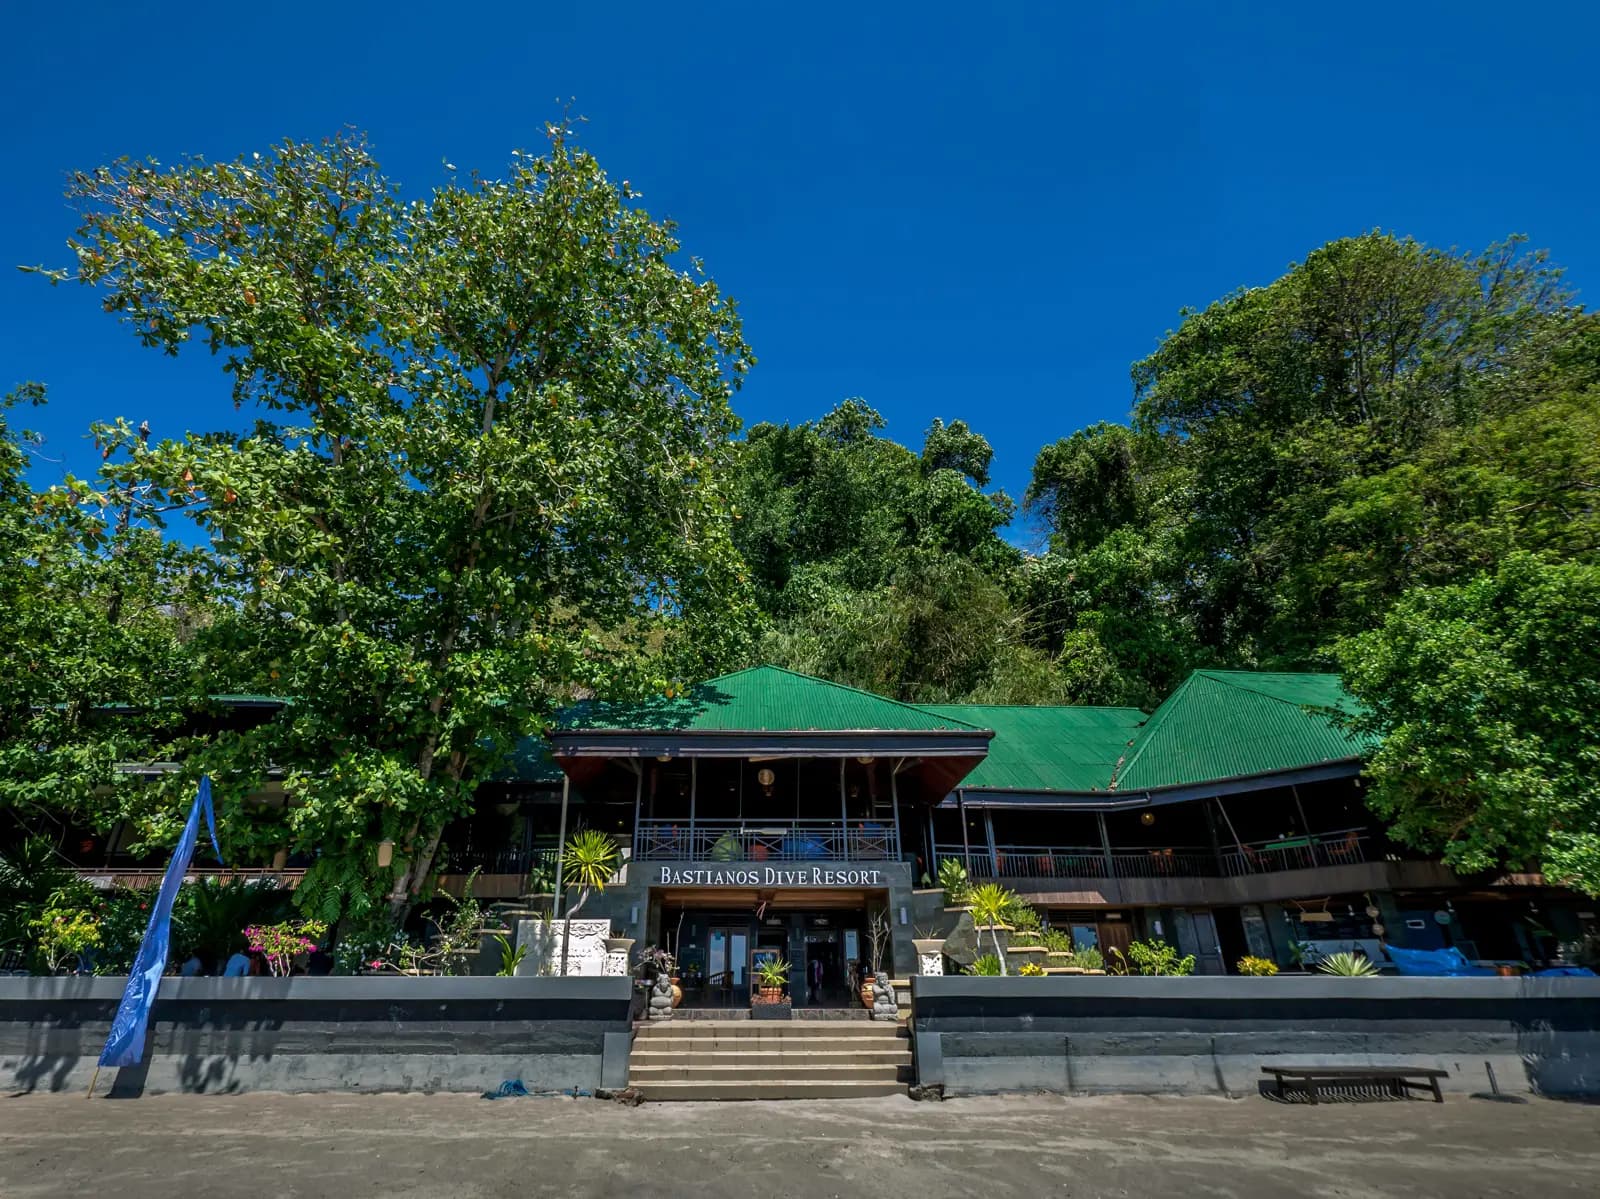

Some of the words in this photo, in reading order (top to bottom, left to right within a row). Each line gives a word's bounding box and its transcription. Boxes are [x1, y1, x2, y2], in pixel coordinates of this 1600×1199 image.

[660, 866, 760, 885] BASTIANOS
[764, 867, 808, 885] DIVE
[812, 867, 880, 885] RESORT
